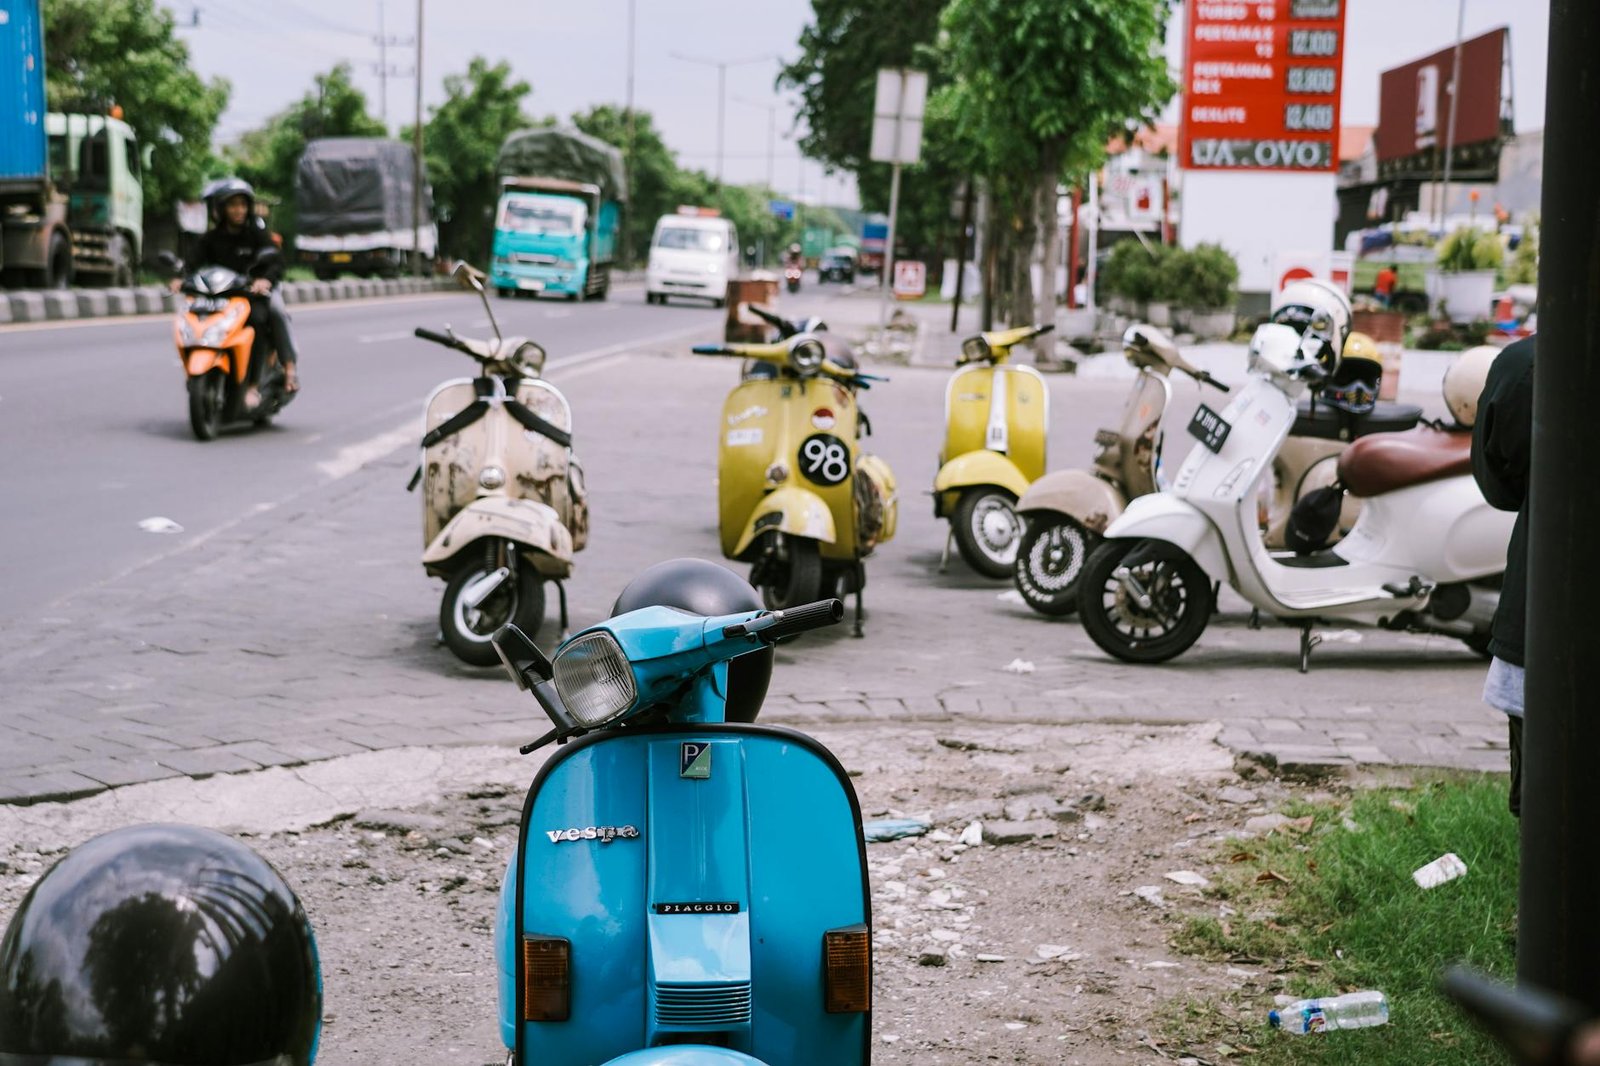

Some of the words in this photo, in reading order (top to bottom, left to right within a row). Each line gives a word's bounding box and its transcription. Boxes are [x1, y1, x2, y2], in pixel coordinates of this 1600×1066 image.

[804, 439, 848, 482] 98
[684, 744, 700, 765] P
[546, 825, 640, 843] vespa
[664, 904, 733, 912] PIAGGIO
